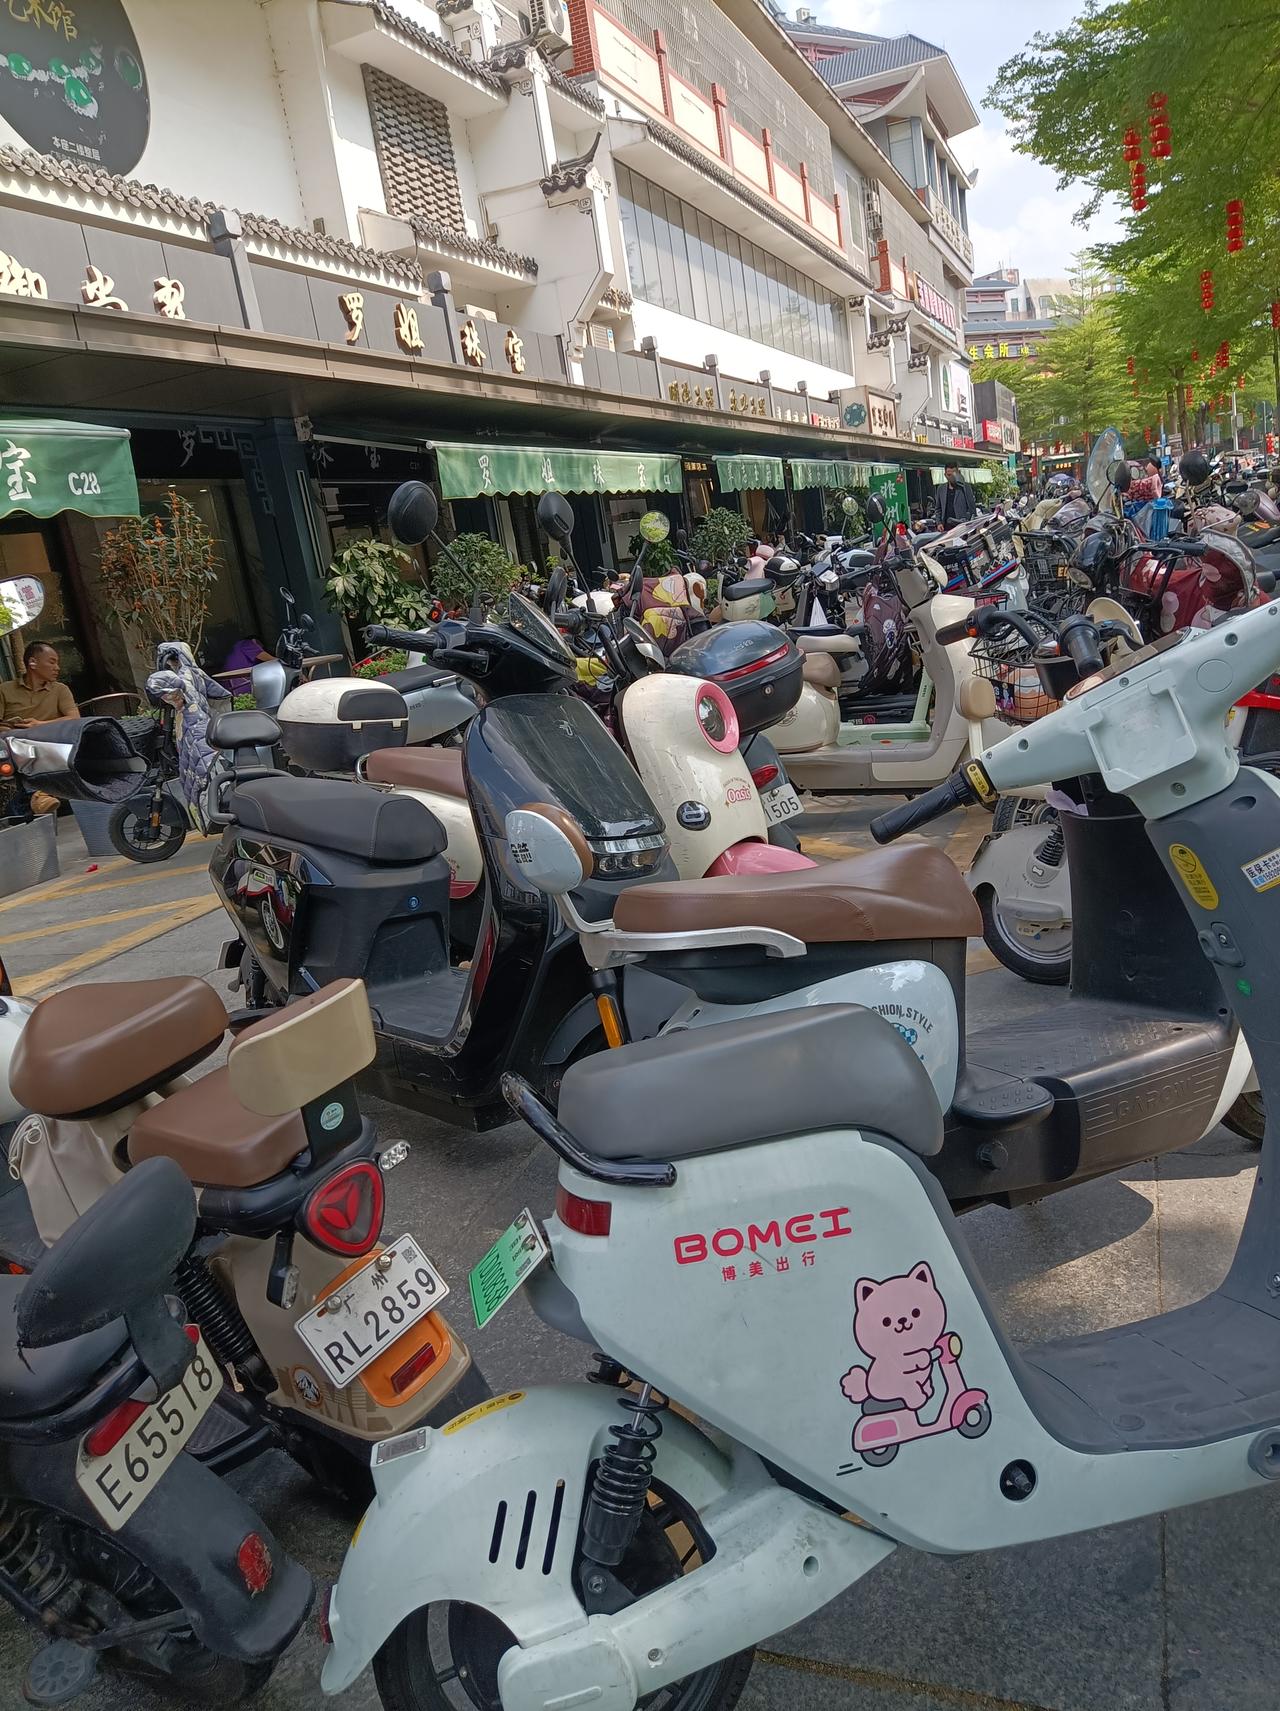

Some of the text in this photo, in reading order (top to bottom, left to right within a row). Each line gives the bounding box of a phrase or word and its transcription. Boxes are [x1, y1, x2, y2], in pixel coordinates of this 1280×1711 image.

[727, 787, 752, 804] Oasis
[906, 1007, 934, 1034] STYLE
[673, 1207, 852, 1265] BOMEI
[721, 1250, 816, 1282] 博美出行
[323, 1267, 436, 1375] RL2859
